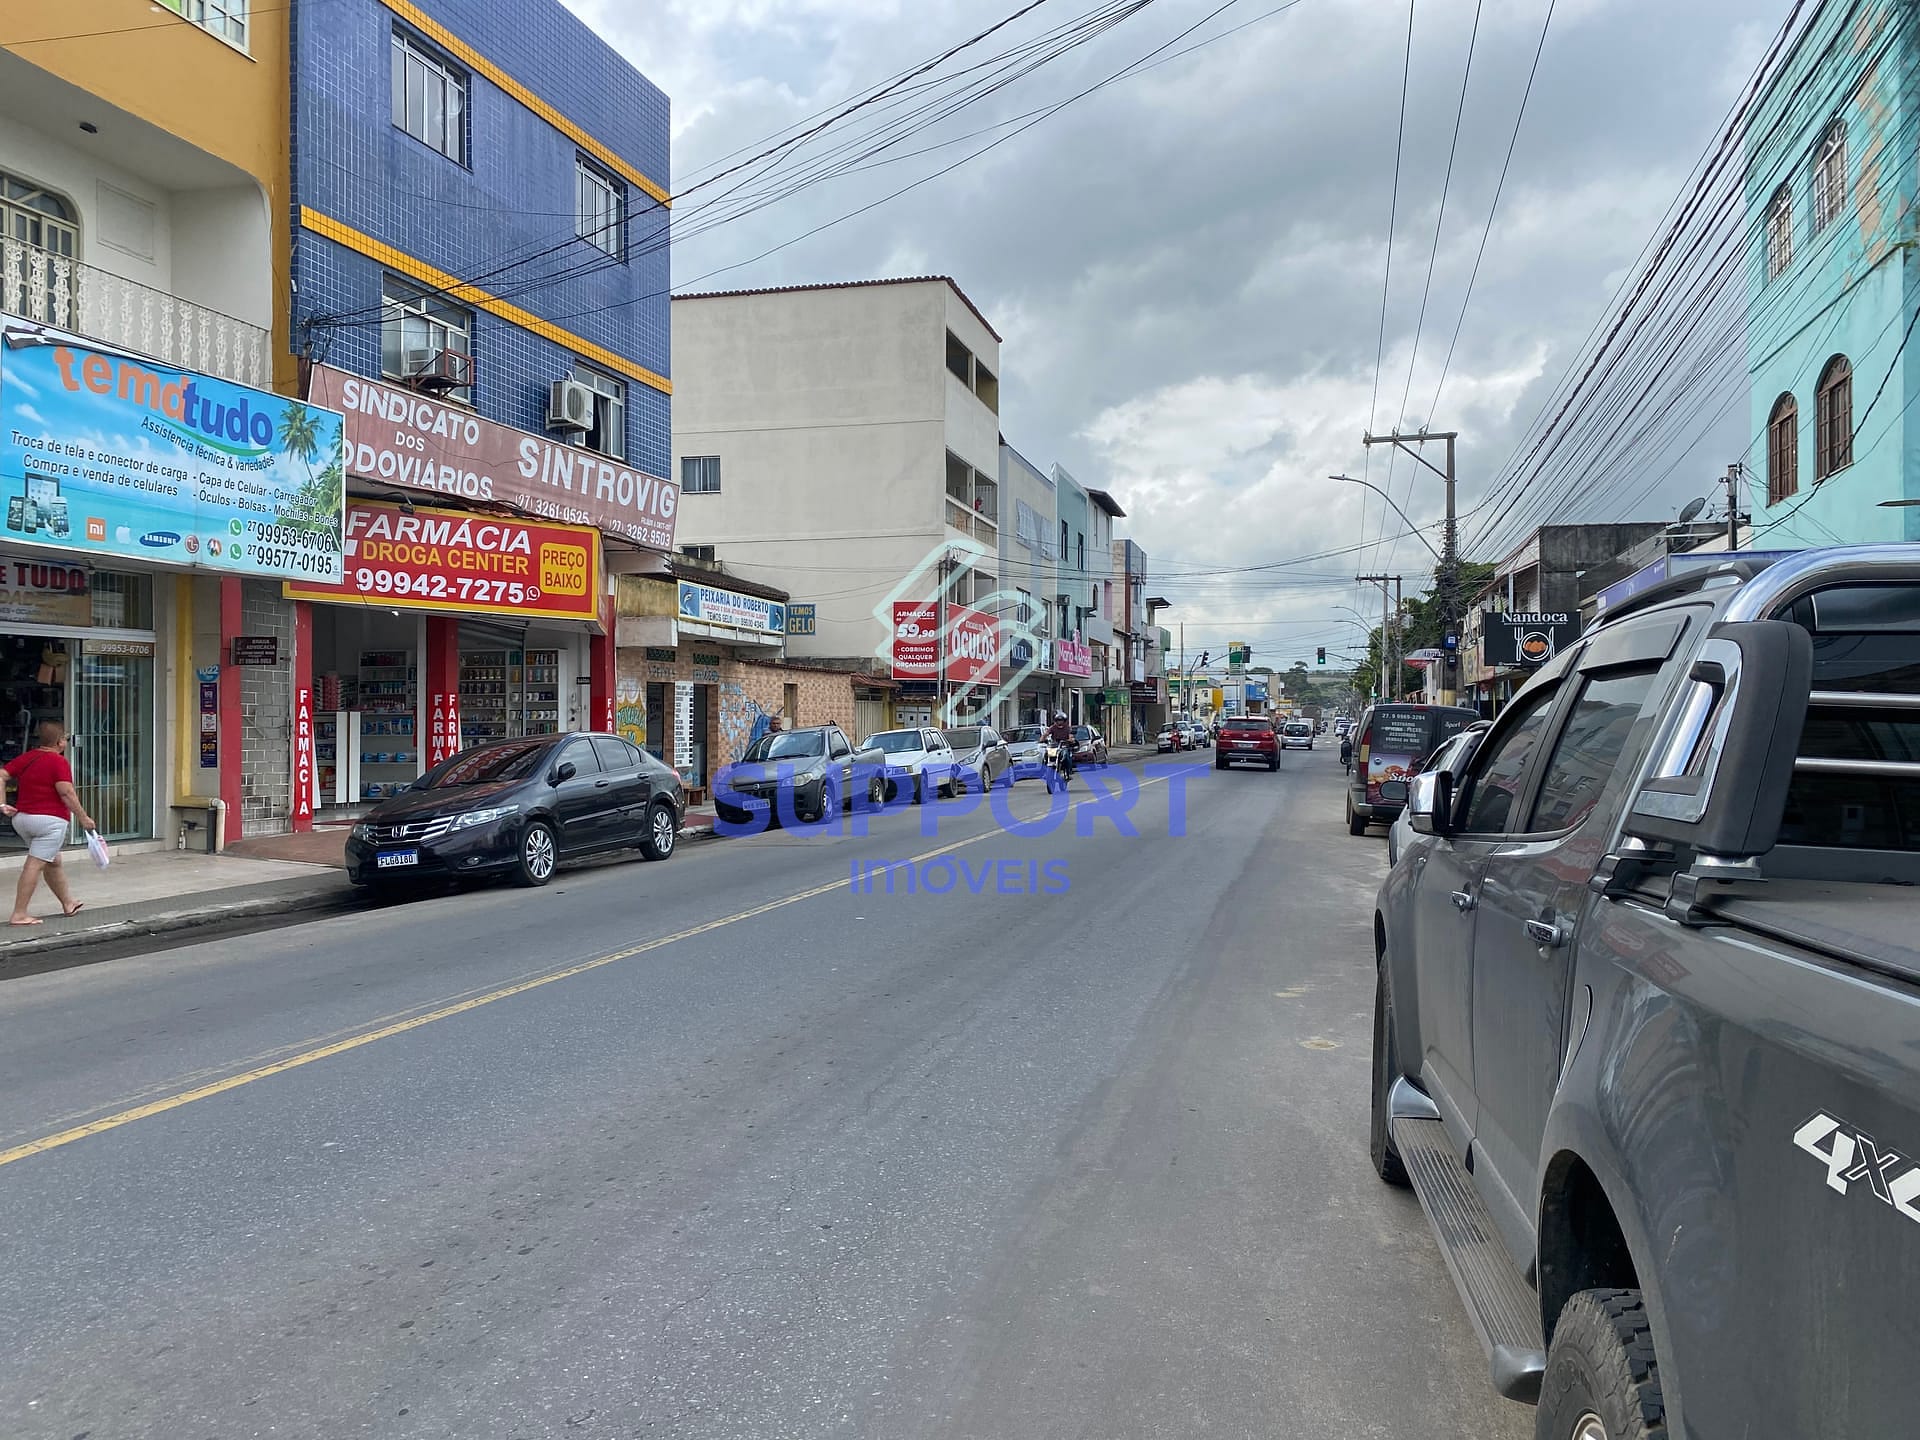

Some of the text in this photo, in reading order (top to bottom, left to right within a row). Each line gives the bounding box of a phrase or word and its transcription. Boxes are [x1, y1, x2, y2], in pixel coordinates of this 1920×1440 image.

[342, 379, 480, 446] SINDICATO
[395, 431, 425, 451] DOS
[11, 430, 317, 506] Troca de tela e conector de carga Capa de Celular Carregador
[195, 444, 225, 468] técnica
[227, 458, 233, 469] &
[236, 455, 275, 471] variedades
[23, 454, 339, 528] Compra e venda de celulares Óculos Bolsas Mochilas Bonés
[517, 438, 675, 518] SINTROVIG
[535, 499, 590, 525] 3261-0525
[247, 520, 333, 552] 27 99953-6706
[347, 511, 532, 554] FARMÁCIA
[626, 523, 671, 547] 3262-9503
[248, 544, 257, 556] 27
[256, 546, 332, 575] 99577-0195
[362, 540, 529, 576] DROGA CENTER
[543, 549, 584, 571] PREÇO
[13, 562, 85, 590] TUDO
[356, 568, 524, 604] 99942-7275
[545, 571, 582, 589] BAIXO
[700, 588, 769, 614] PEIXARIA DO ROBERTO
[790, 606, 813, 615] TEMOS
[896, 610, 935, 618] ARMAÇÕES
[789, 618, 814, 633] GELO
[1501, 612, 1569, 623] Nandoca
[896, 623, 935, 639] 59,90
